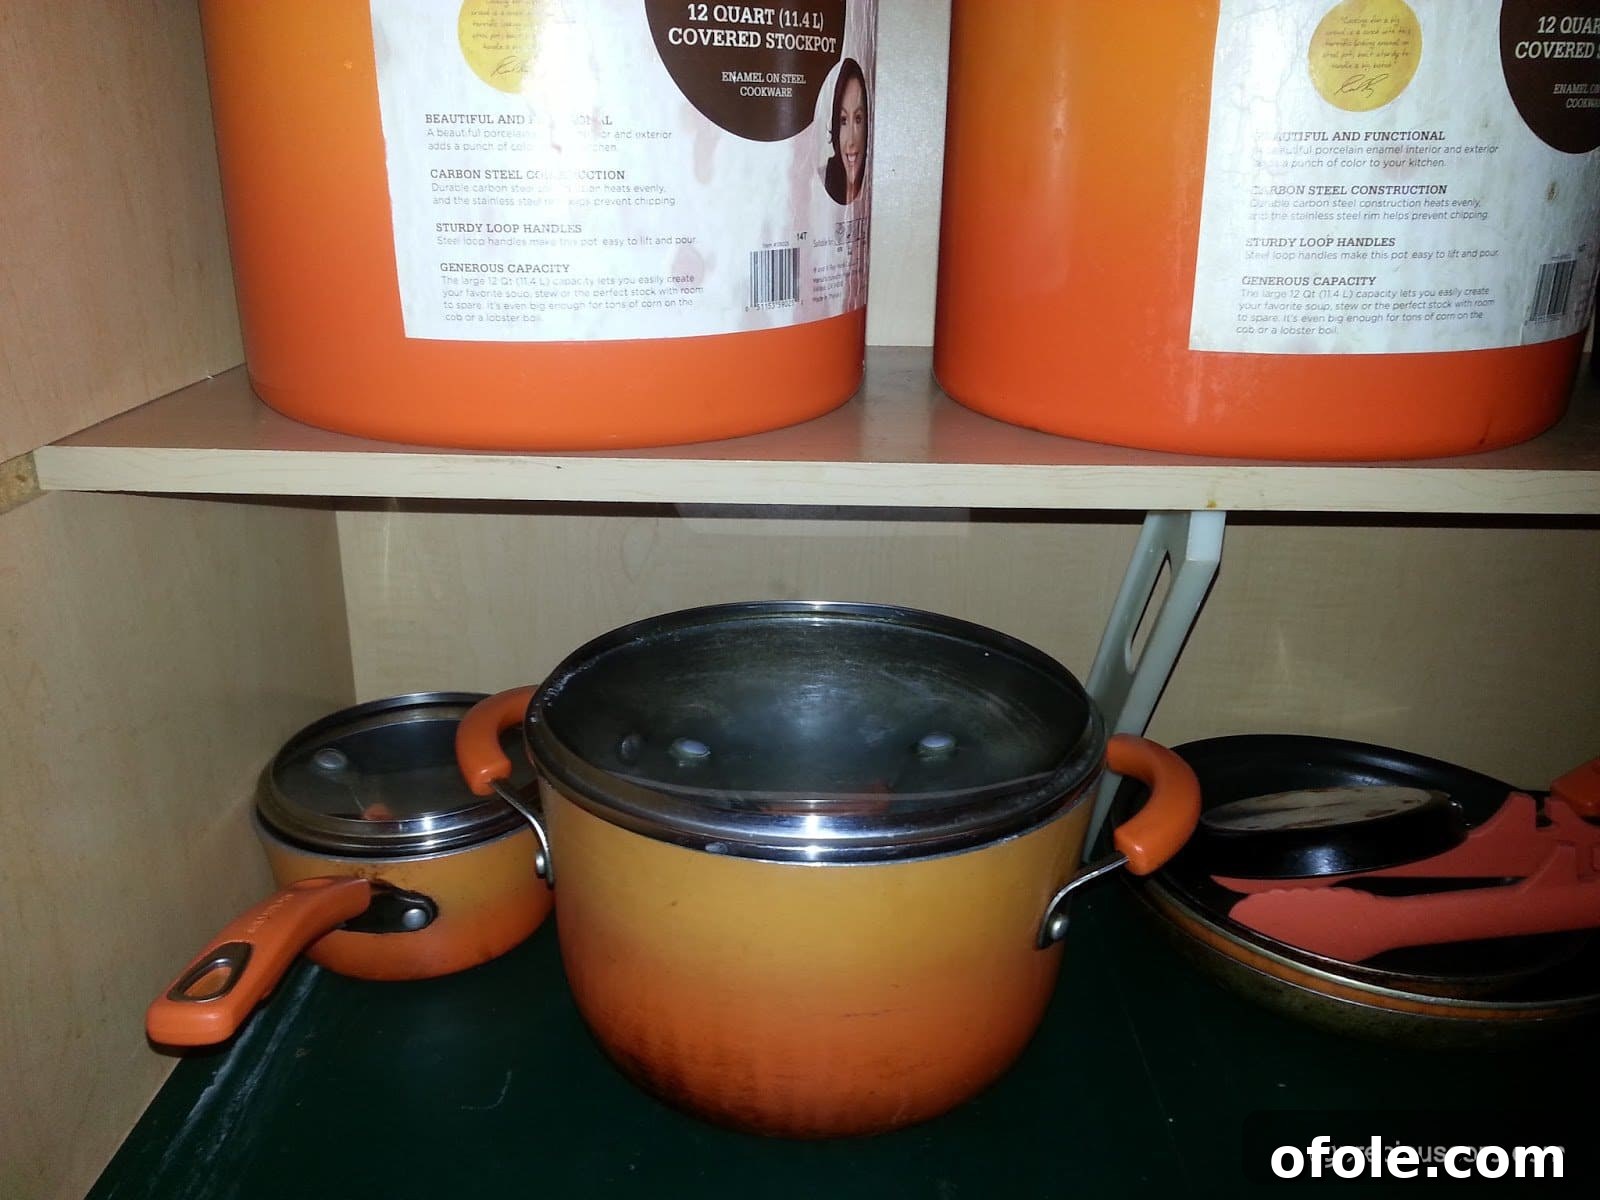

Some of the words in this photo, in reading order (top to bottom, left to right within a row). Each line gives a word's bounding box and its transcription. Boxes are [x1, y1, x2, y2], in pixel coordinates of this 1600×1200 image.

[688, 4, 708, 21] 12
[713, 5, 775, 25] QUART
[779, 8, 810, 29] (11.4
[812, 12, 824, 31] L)
[1537, 16, 1557, 34] 12
[668, 28, 761, 48] COVERED
[766, 33, 836, 53] STOCKPOT
[1515, 41, 1595, 59] COVERED
[722, 71, 765, 83] ENAMEL
[767, 73, 780, 83] ON
[781, 74, 807, 84] STEEL
[740, 87, 792, 97] COOKWARE
[425, 114, 494, 124] BEAUTIFUL
[498, 115, 525, 125] AND
[437, 128, 481, 138] beautiful
[1332, 132, 1361, 142] AND
[1364, 131, 1446, 141] FUNCTIONAL
[1315, 145, 1364, 155] porcelain
[1367, 145, 1403, 154] enamel
[1405, 145, 1441, 154] interior
[1444, 145, 1462, 154] and
[1464, 145, 1499, 154] exterior
[1327, 158, 1338, 168] of
[1341, 159, 1367, 168] color
[1370, 159, 1381, 168] to
[1383, 160, 1406, 169] your
[430, 169, 481, 179] CARBON
[485, 170, 523, 180] STEEL
[472, 183, 508, 193] carbon
[1308, 186, 1348, 196] STEEL
[1351, 185, 1448, 195] CONSTRUCTION
[1293, 199, 1330, 208] carbon
[1332, 200, 1356, 208] steel
[1360, 199, 1421, 208] construction
[1424, 198, 1450, 207] heats
[1290, 212, 1335, 221] stainless
[1337, 212, 1361, 221] steel
[1364, 212, 1380, 221] rim
[1384, 212, 1409, 222] helps
[1412, 212, 1448, 222] prevent
[436, 223, 483, 233] STURDY
[486, 224, 520, 233] LOOP
[523, 224, 583, 234] HANDLES
[602, 238, 624, 248] easy
[627, 237, 638, 246] to
[640, 237, 653, 246] lift
[655, 237, 673, 245] and
[1245, 238, 1297, 247] STURDY
[1299, 238, 1334, 247] LOOP
[1337, 238, 1396, 247] HANDLES
[1298, 251, 1338, 260] handles
[1341, 251, 1368, 260] make
[1371, 250, 1389, 260] this
[1391, 251, 1408, 261] pot
[1412, 251, 1434, 261] easy
[1436, 251, 1446, 260] to
[1461, 249, 1478, 258] and
[440, 263, 504, 273] GENEROUS
[507, 264, 570, 274] CAPACITY
[618, 277, 636, 287] you
[639, 275, 664, 286] easily
[667, 275, 695, 284] create
[1242, 276, 1310, 286] GENEROUS
[1313, 276, 1377, 286] CAPACITY
[535, 290, 558, 299] stew
[593, 287, 629, 299] perfect
[632, 287, 657, 297] stock
[660, 286, 678, 296] with
[1263, 290, 1287, 299] large
[1290, 290, 1300, 299] 12
[1303, 290, 1316, 299] Qt
[1356, 289, 1397, 299] capacity
[1400, 289, 1417, 298] lets
[1419, 289, 1436, 299] you
[1438, 288, 1462, 298] easily
[1464, 288, 1490, 296] create
[504, 302, 527, 311] even
[628, 300, 639, 309] of
[641, 300, 662, 309] corn
[665, 300, 677, 308] on
[679, 298, 693, 307] the
[1264, 301, 1302, 311] favorite
[1336, 302, 1360, 311] stew
[1362, 303, 1372, 311] or
[1375, 302, 1391, 310] the
[1392, 301, 1426, 311] perfect
[1428, 300, 1452, 310] stock
[466, 314, 476, 322] or
[478, 314, 484, 322] a
[1301, 315, 1327, 323] even
[1328, 314, 1344, 325] big
[1346, 314, 1384, 324] enough
[1387, 313, 1399, 322] for
[1402, 313, 1422, 322] tons
[1425, 312, 1435, 321] of
[1436, 313, 1457, 321] corn
[1457, 312, 1469, 320] on
[1470, 311, 1483, 319] the
[1280, 326, 1316, 335] lobster
